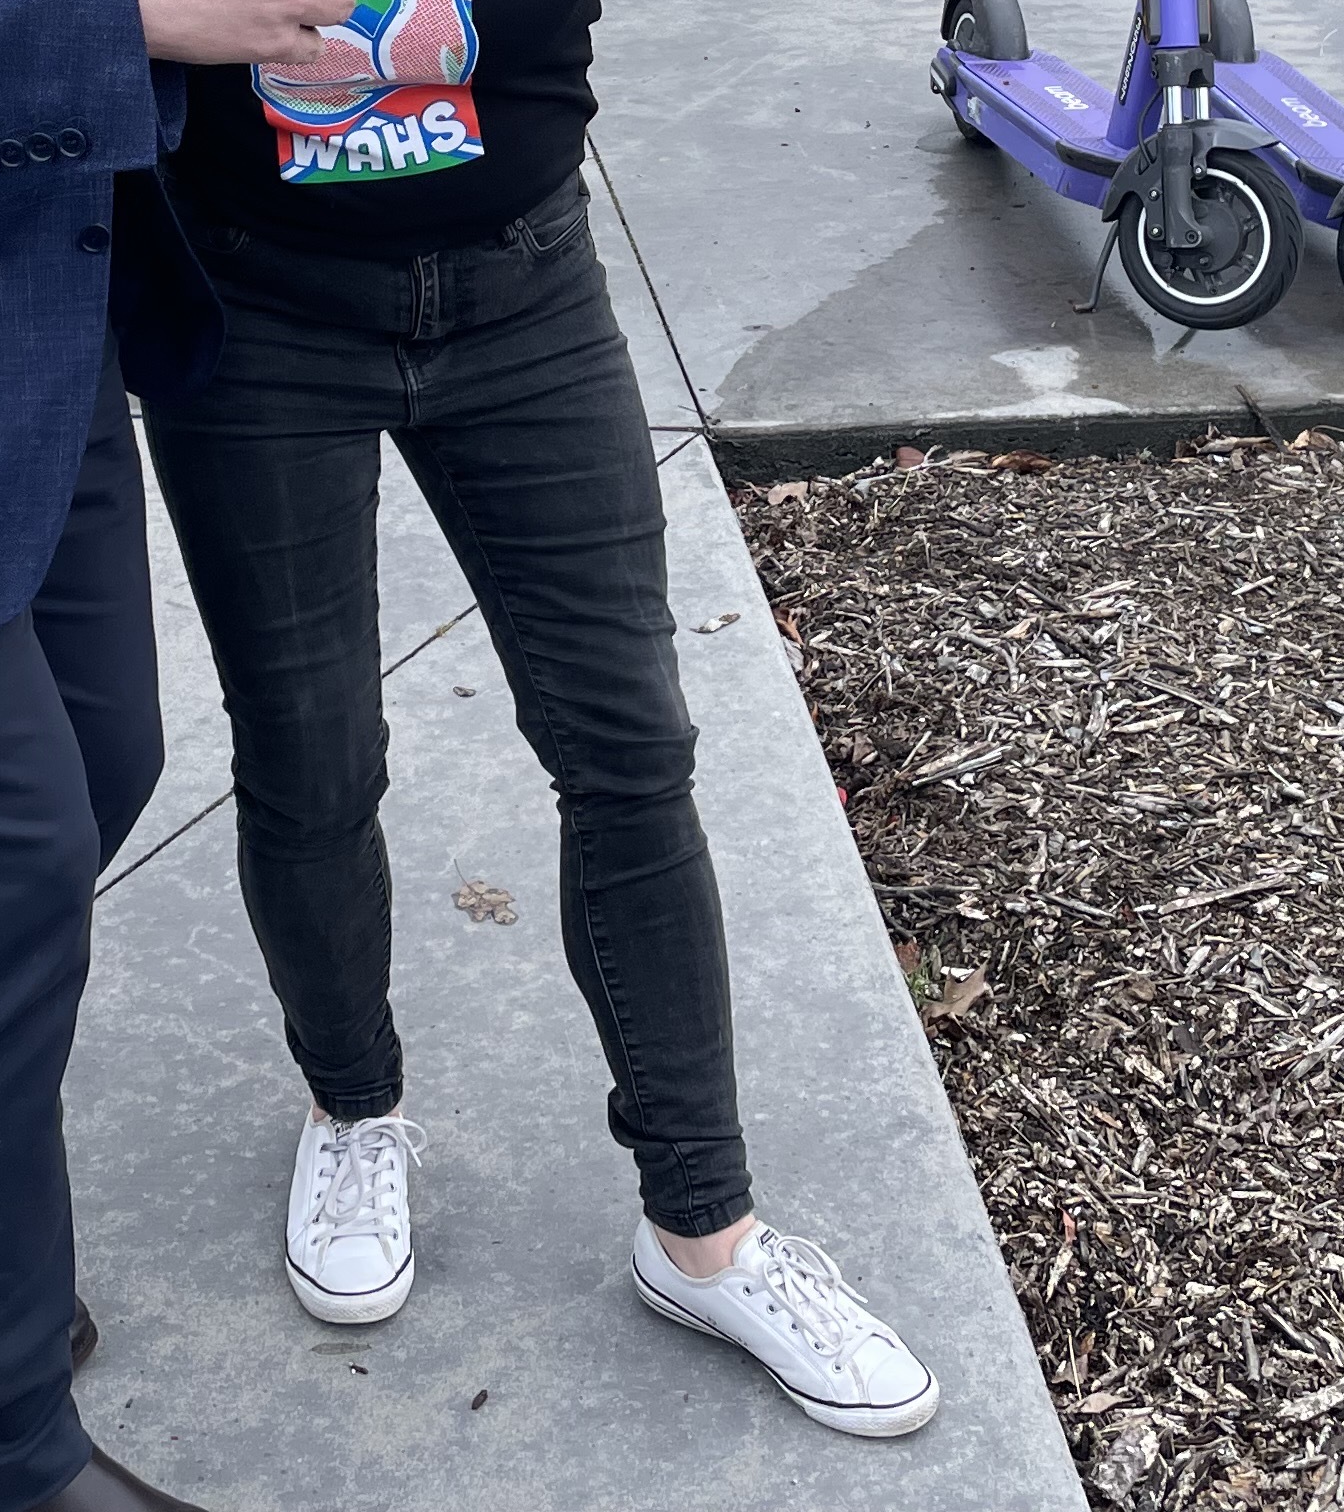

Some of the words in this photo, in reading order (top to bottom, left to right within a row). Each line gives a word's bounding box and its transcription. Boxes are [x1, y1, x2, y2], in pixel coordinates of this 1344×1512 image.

[1044, 85, 1089, 110] beam
[1280, 97, 1328, 127] beam
[290, 100, 467, 172] WAHS
